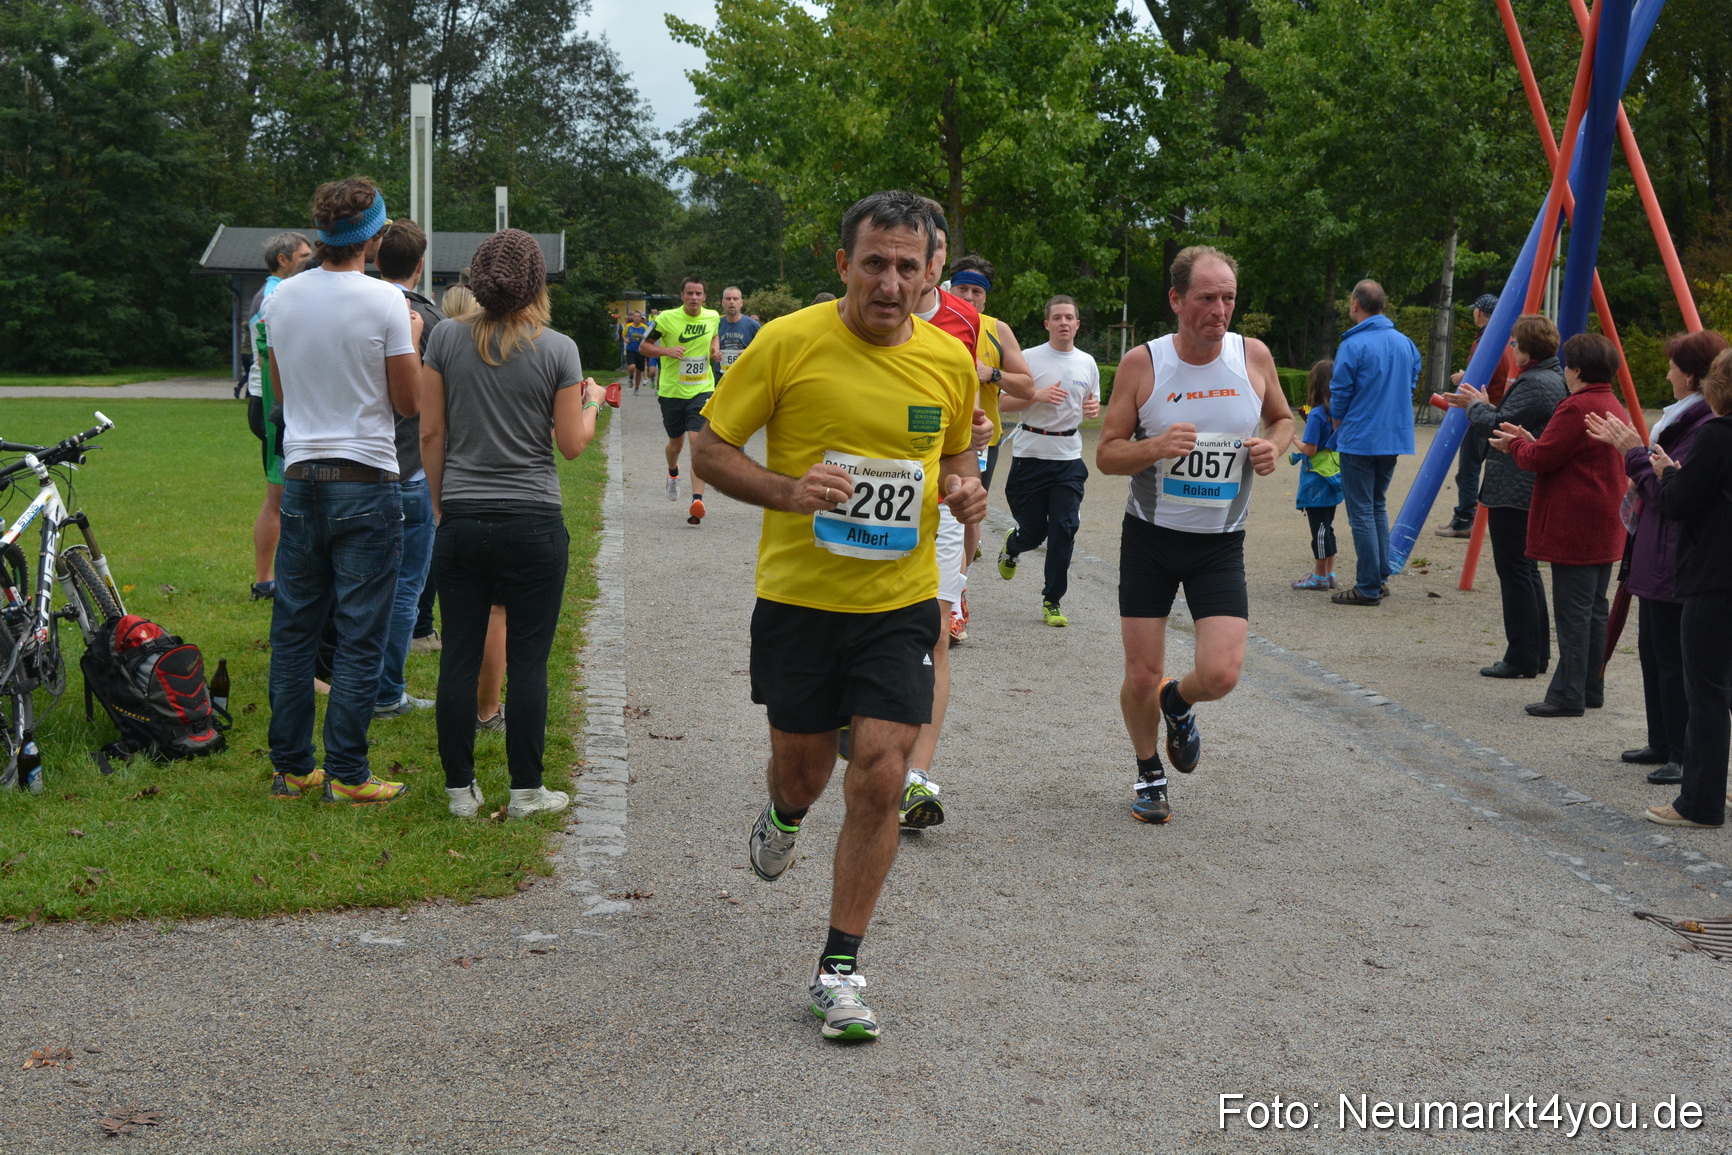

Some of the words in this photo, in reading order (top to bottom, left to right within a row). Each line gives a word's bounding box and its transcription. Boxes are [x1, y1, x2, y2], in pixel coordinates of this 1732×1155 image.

[684, 324, 707, 335] RUN
[686, 362, 704, 374] 289
[1187, 388, 1241, 400] KLEBL
[1170, 450, 1237, 479] 2057
[862, 467, 912, 480] Neumarkt
[1183, 484, 1220, 497] Roland
[828, 481, 915, 522] 282
[17, 503, 39, 528] STING
[846, 527, 889, 546] Albert
